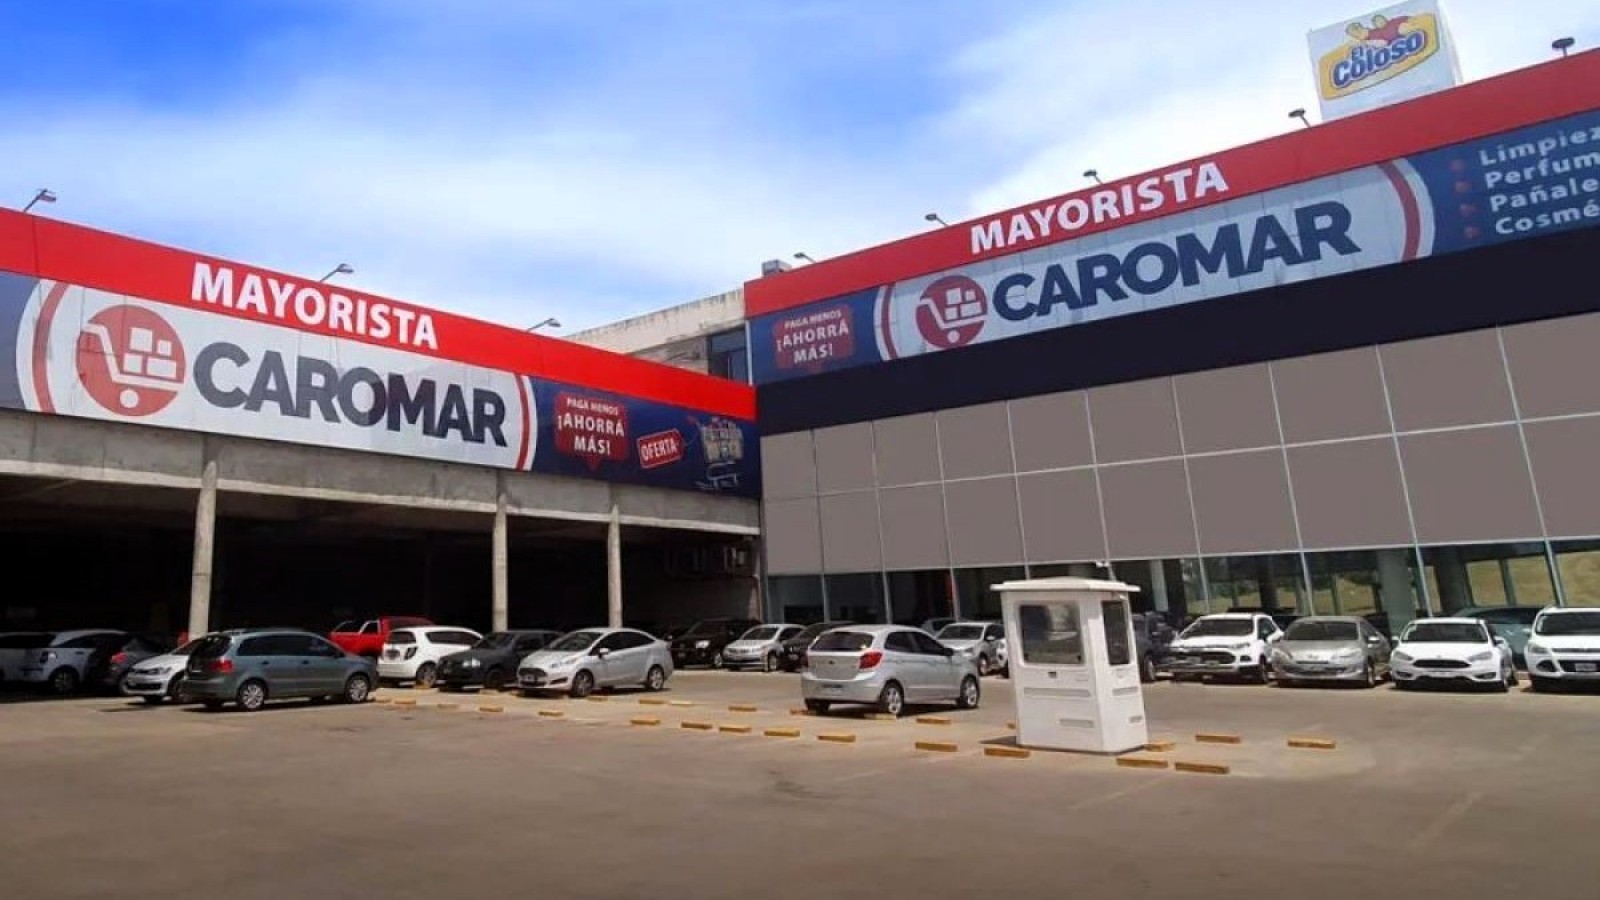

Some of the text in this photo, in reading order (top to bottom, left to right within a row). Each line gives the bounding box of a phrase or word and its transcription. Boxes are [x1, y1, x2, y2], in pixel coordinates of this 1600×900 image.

[1333, 31, 1424, 86] Coloso
[1484, 151, 1600, 189] Perfum
[1490, 177, 1600, 212] Pañale
[970, 163, 1229, 255] MAYORISTA
[1495, 199, 1600, 234] Cosmé
[992, 200, 1362, 321] CAROMAR
[191, 262, 439, 350] MAYORISTA
[193, 342, 507, 448] CAROMAR
[640, 437, 679, 461] OFERTA
